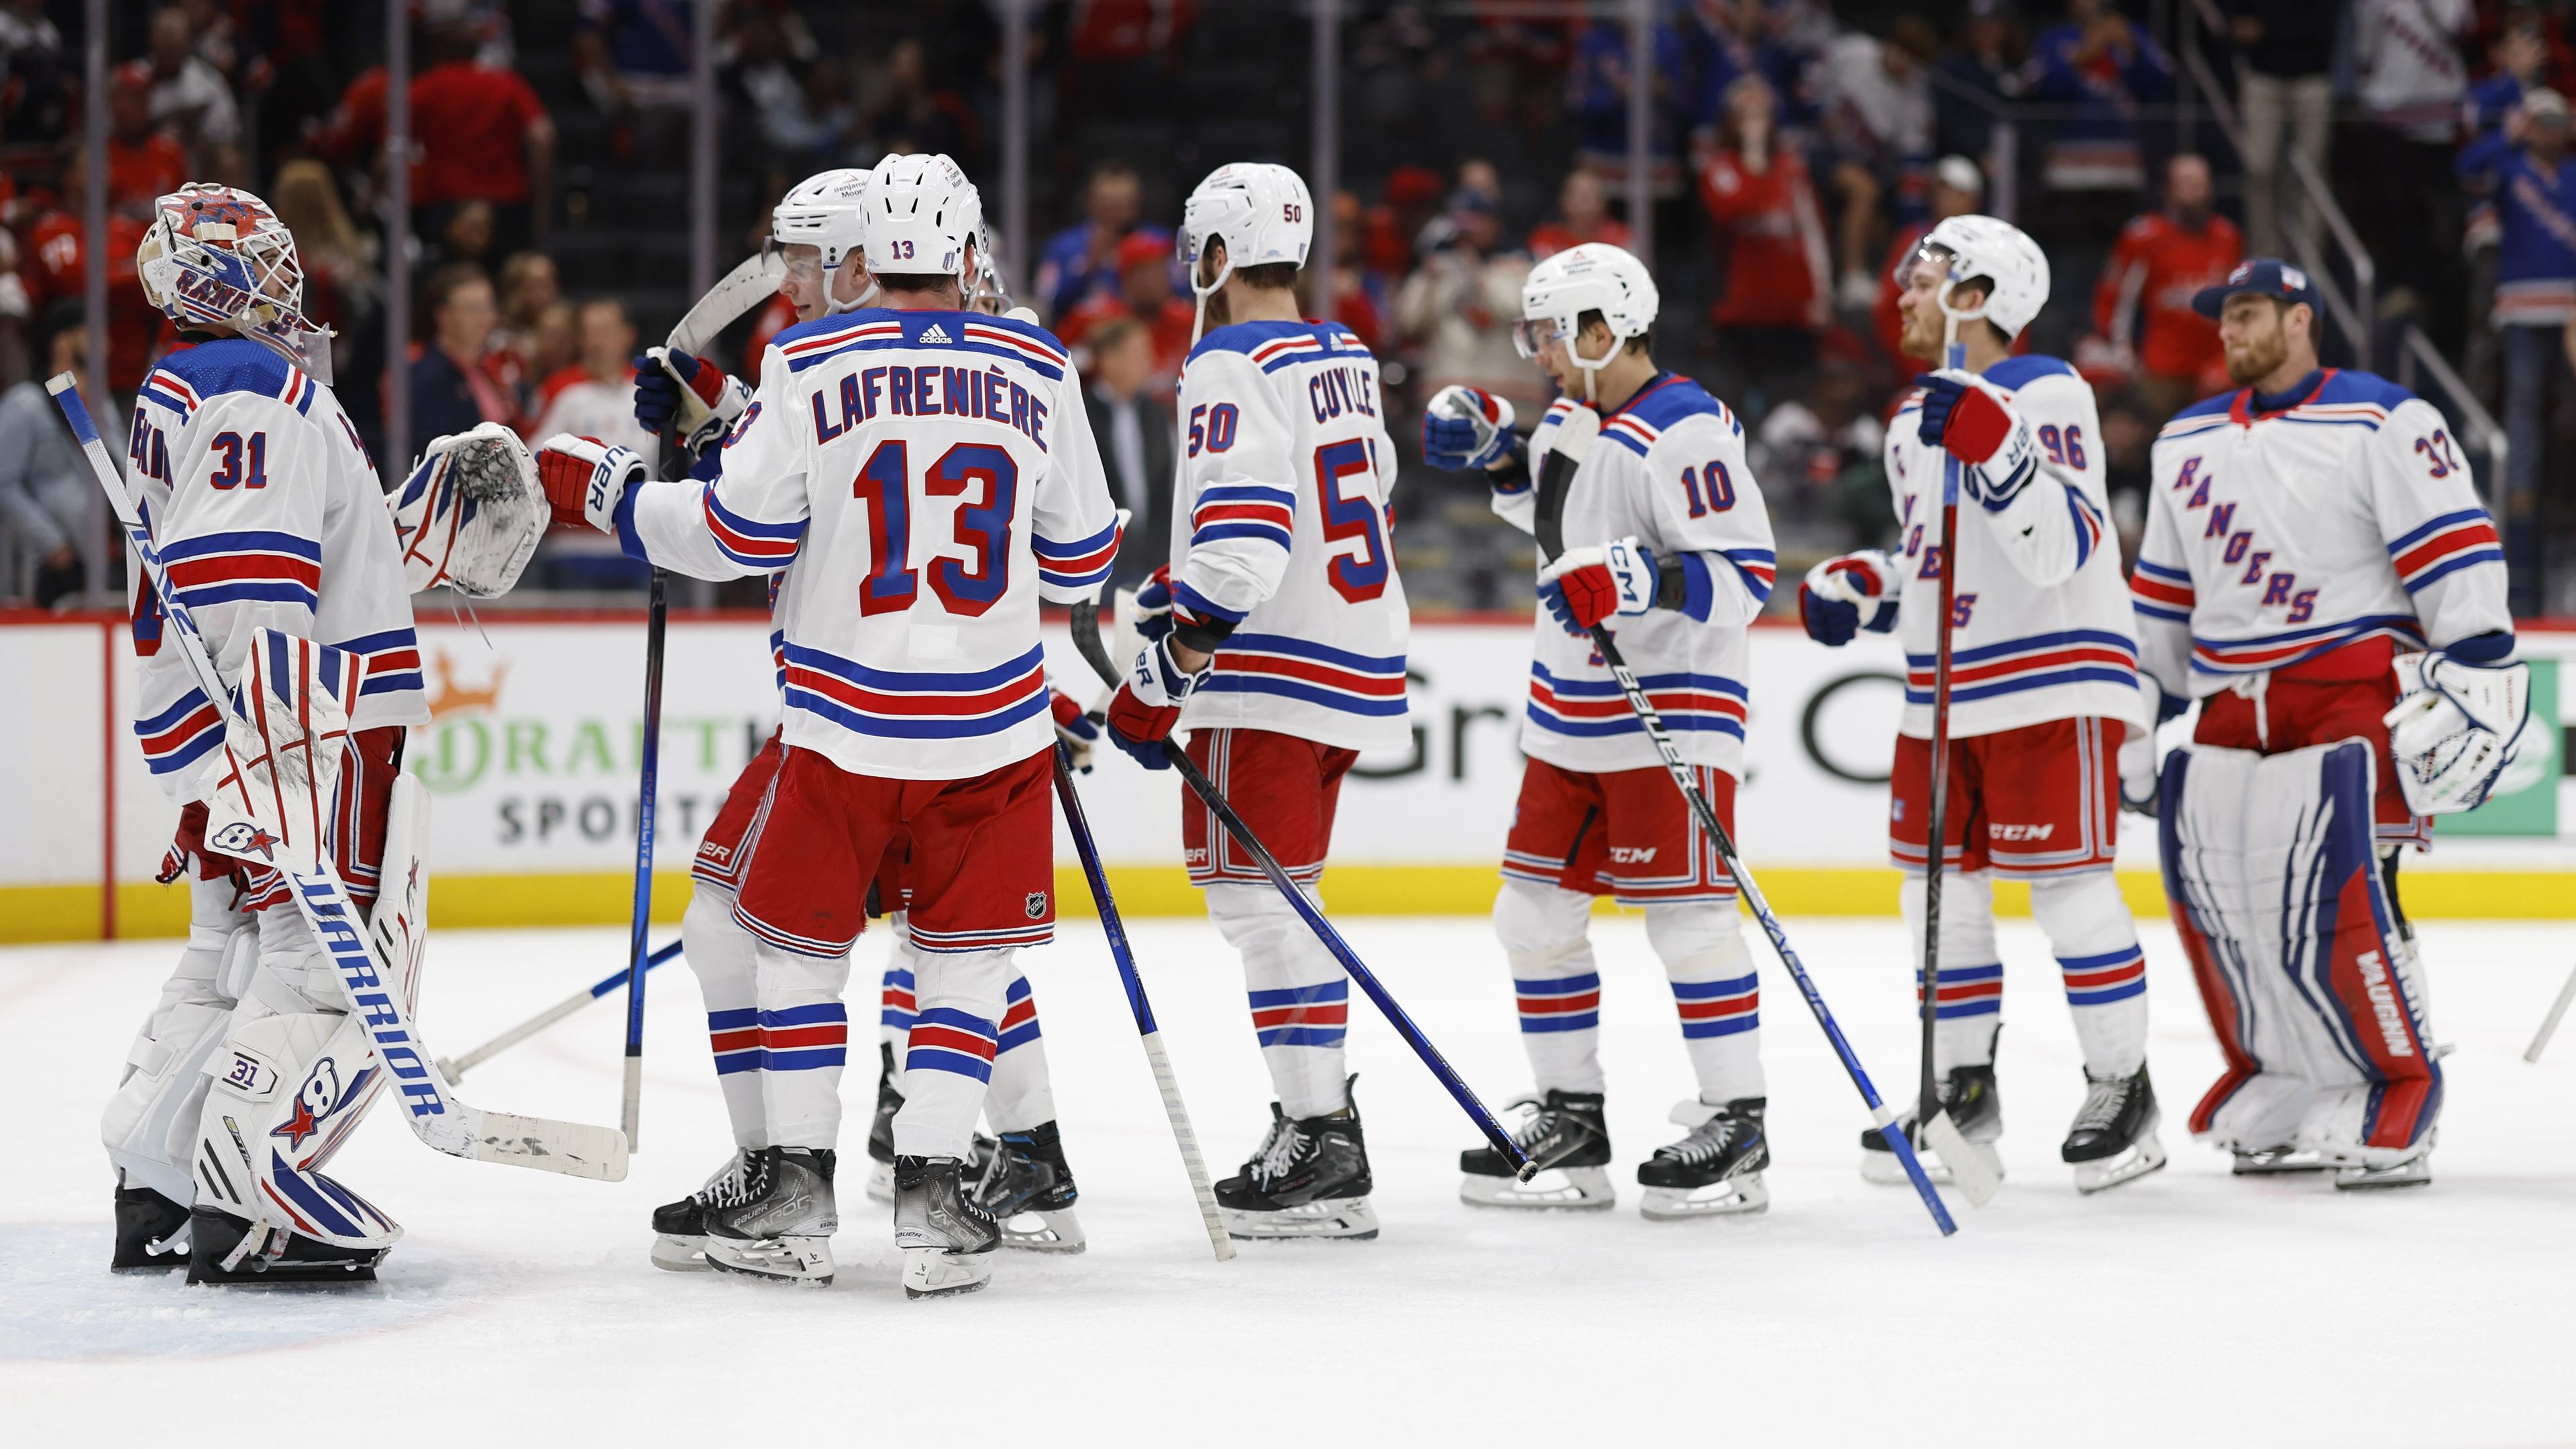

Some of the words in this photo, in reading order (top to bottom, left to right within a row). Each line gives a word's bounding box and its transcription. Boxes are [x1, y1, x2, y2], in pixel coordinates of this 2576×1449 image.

[833, 179, 868, 193] Benjami
[1283, 203, 1301, 223] 50
[892, 240, 914, 260] 13
[919, 335, 953, 344] adidas
[812, 364, 1048, 454] LAFRENIÈRE
[1309, 366, 1375, 424] CUYLLE
[722, 400, 763, 449] 3
[1188, 402, 1240, 459] 50
[2038, 425, 2087, 472] 96
[2415, 428, 2461, 478] 32
[210, 431, 267, 490] 31
[587, 445, 633, 513] UER
[1680, 460, 1736, 520] 10
[853, 439, 1019, 618] 13
[1313, 436, 1393, 605] 5
[2174, 457, 2320, 624] RANGERS
[1610, 545, 1639, 602] CM
[1030, 900, 1043, 914] NHL
[292, 864, 445, 1118] WARRIOR
[2356, 949, 2414, 1057] VAUGHN
[230, 1059, 258, 1088] 31
[819, 1220, 838, 1230] BAU
